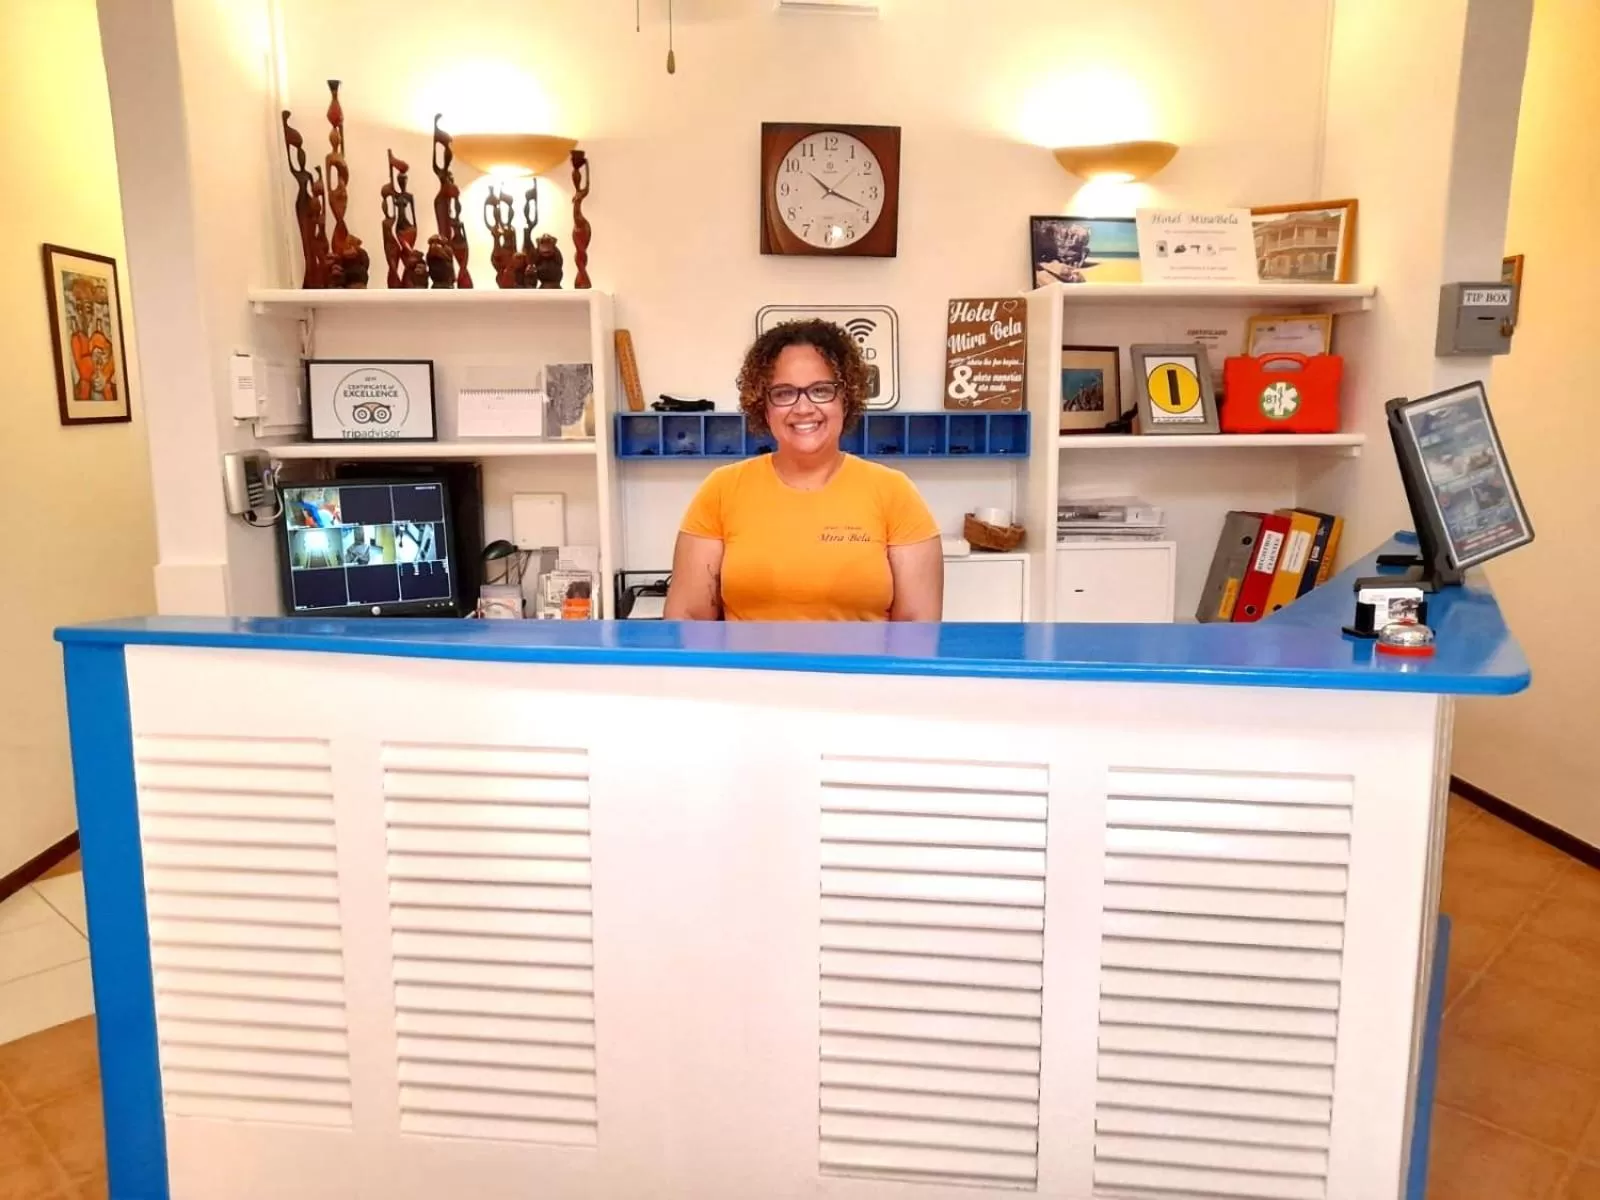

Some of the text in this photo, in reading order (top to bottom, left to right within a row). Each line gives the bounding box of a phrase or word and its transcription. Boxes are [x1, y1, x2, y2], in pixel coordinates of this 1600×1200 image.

[801, 143, 815, 158] 11
[823, 136, 839, 151] 12
[849, 145, 855, 159] 1
[784, 159, 800, 173] 10
[863, 160, 873, 176] 2
[780, 183, 790, 197] 9
[868, 186, 878, 200] 3
[787, 207, 797, 221] 8
[862, 210, 870, 224] 4
[1152, 212, 1182, 225] Hotel
[802, 224, 811, 238] 7
[846, 225, 855, 239] 5
[1466, 291, 1508, 303] TIP BOX
[949, 300, 999, 324] Hotel
[947, 316, 1022, 355] Mira Bela
[947, 365, 979, 400] &
[341, 428, 401, 439] tripadvisor
[820, 532, 870, 542] Mira Bela
